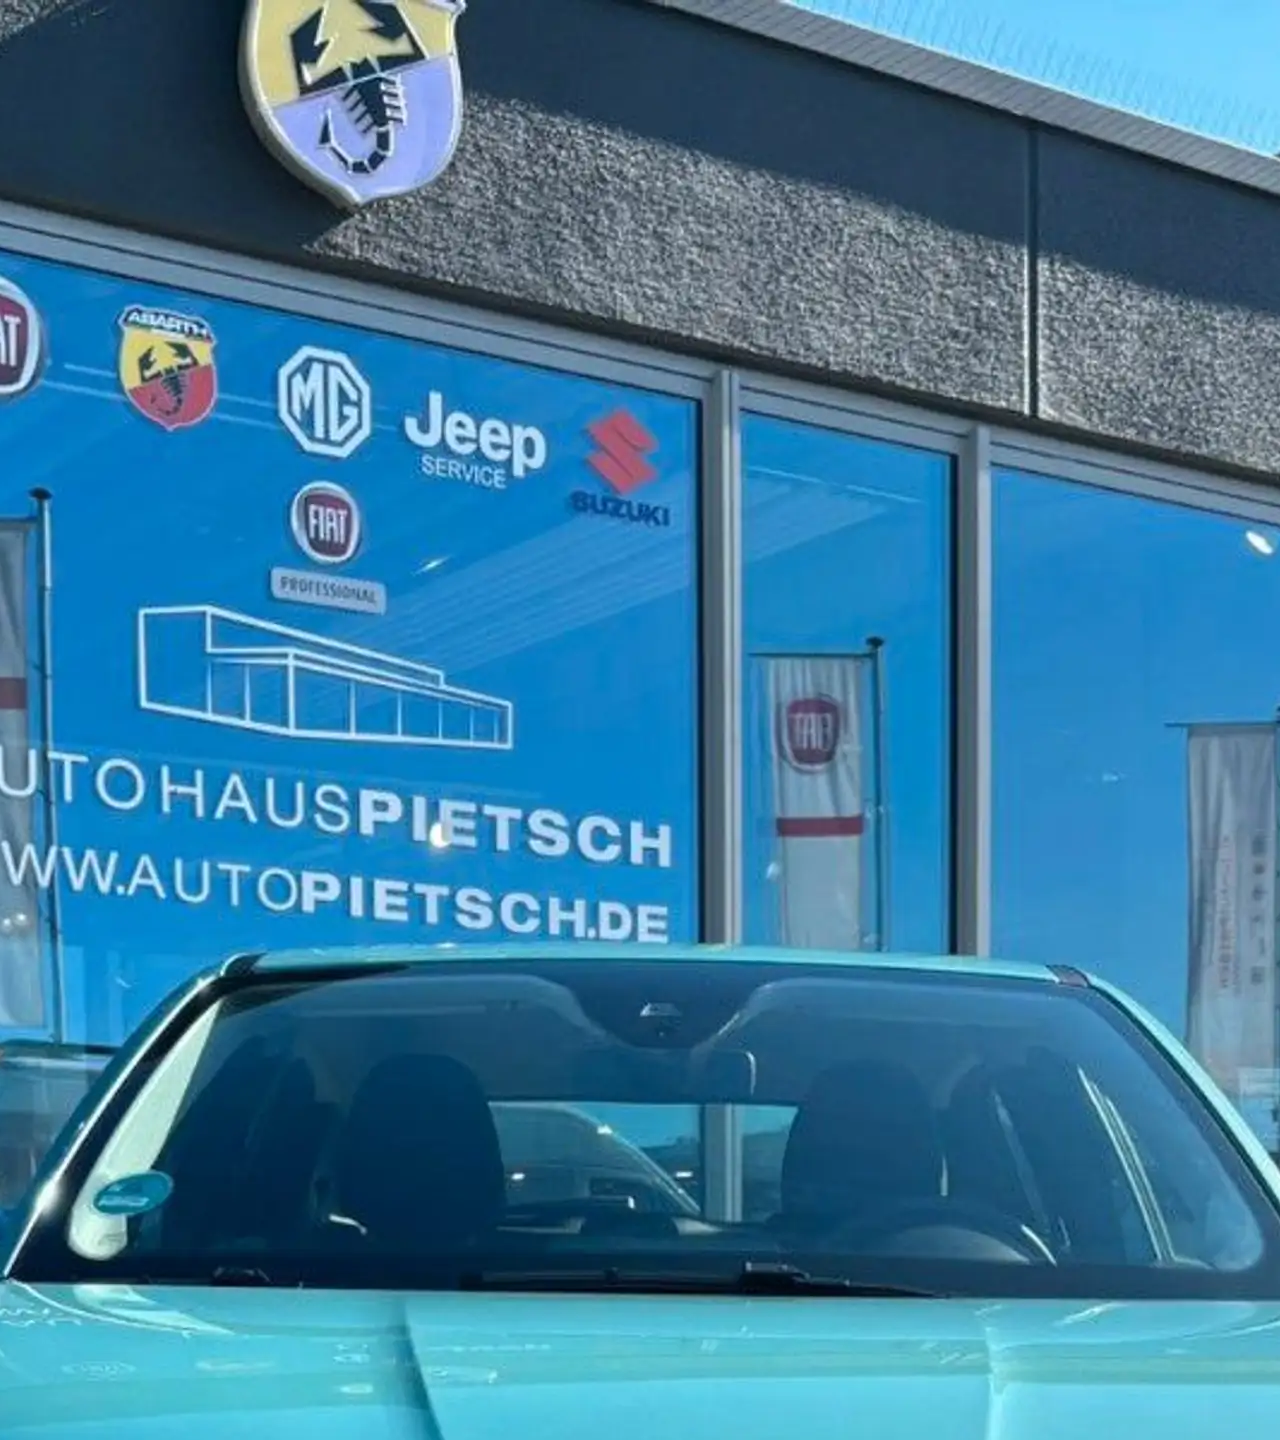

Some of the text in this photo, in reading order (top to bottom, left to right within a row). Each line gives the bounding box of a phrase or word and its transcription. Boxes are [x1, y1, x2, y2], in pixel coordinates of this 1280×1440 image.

[127, 309, 212, 340] ABARTH
[290, 374, 362, 440] MG
[404, 391, 547, 475] Jeep
[420, 454, 507, 490] SERVICE
[306, 503, 349, 545] FIAT
[571, 490, 671, 528] SUZUKI
[279, 575, 377, 604] PROFESSIONAL
